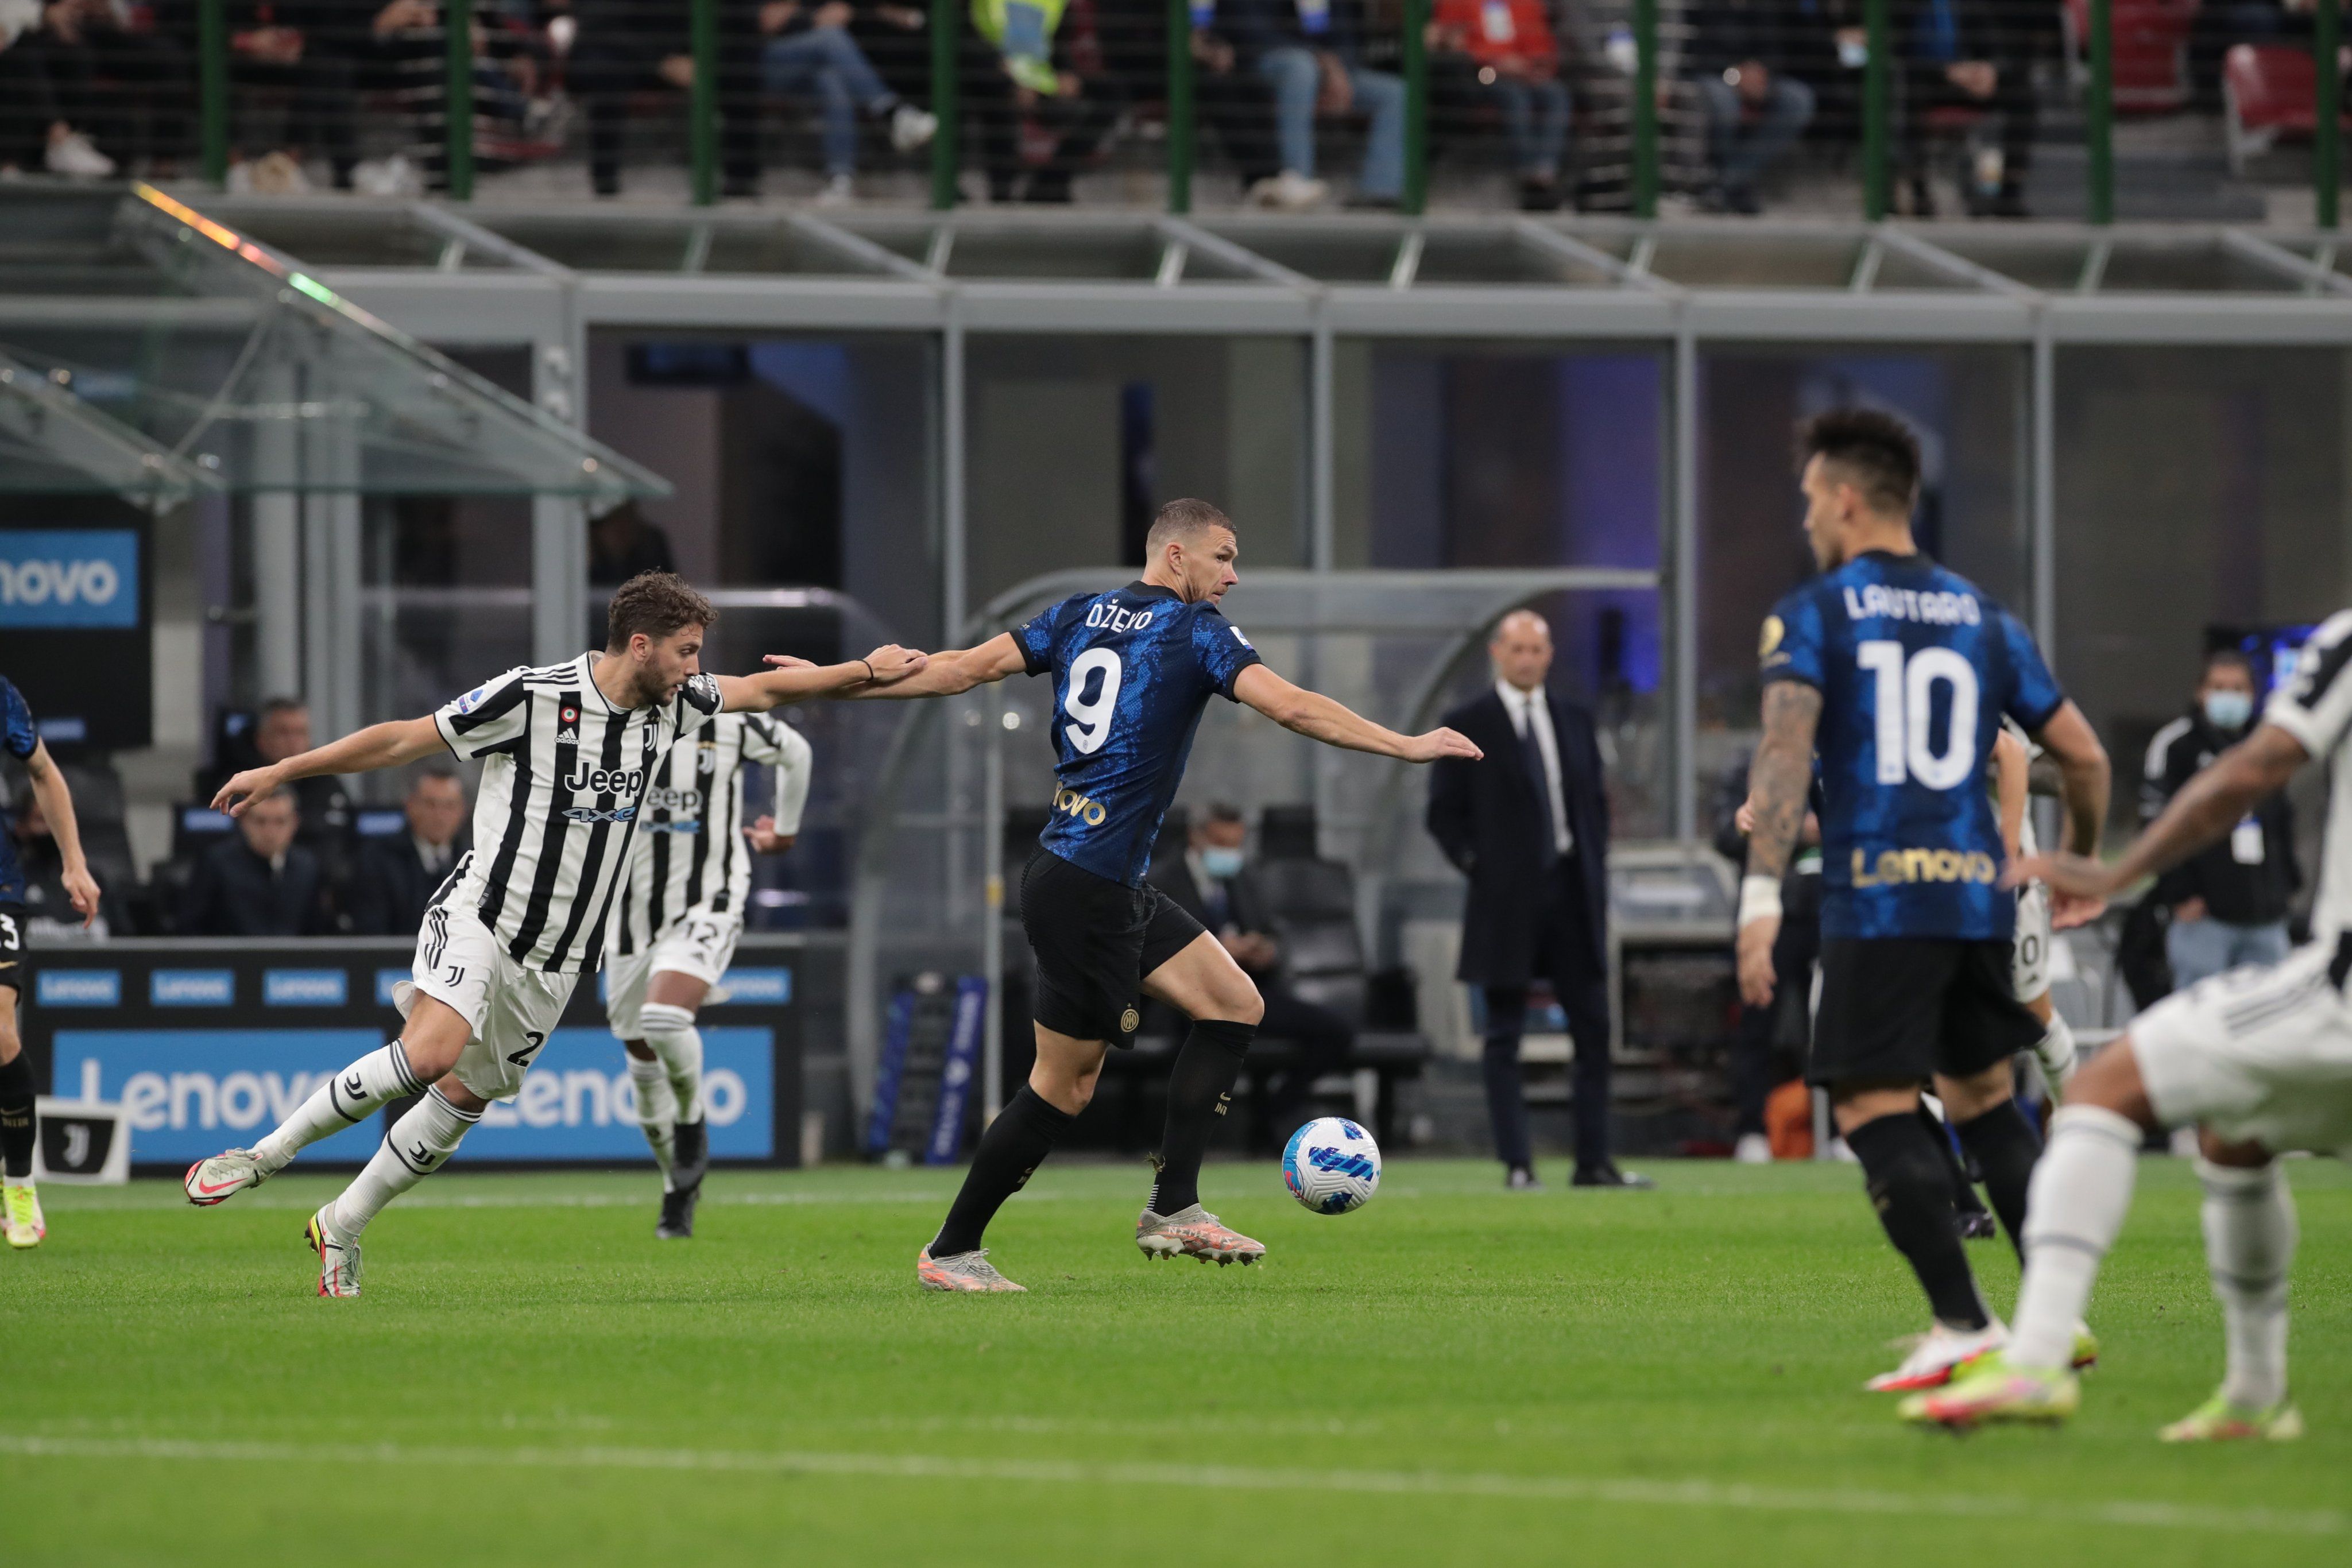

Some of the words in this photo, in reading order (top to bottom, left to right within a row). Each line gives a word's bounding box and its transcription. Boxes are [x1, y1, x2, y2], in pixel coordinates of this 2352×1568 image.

[1843, 583, 1981, 626] LAUTARO
[1065, 648, 1121, 754] 9
[1857, 640, 1979, 790] 10
[564, 761, 643, 799] Jeep
[644, 786, 703, 813] eep
[1851, 847, 1997, 889] Lenovo
[0, 913, 20, 950] 3
[687, 920, 718, 951] 12
[506, 1031, 544, 1067] 2
